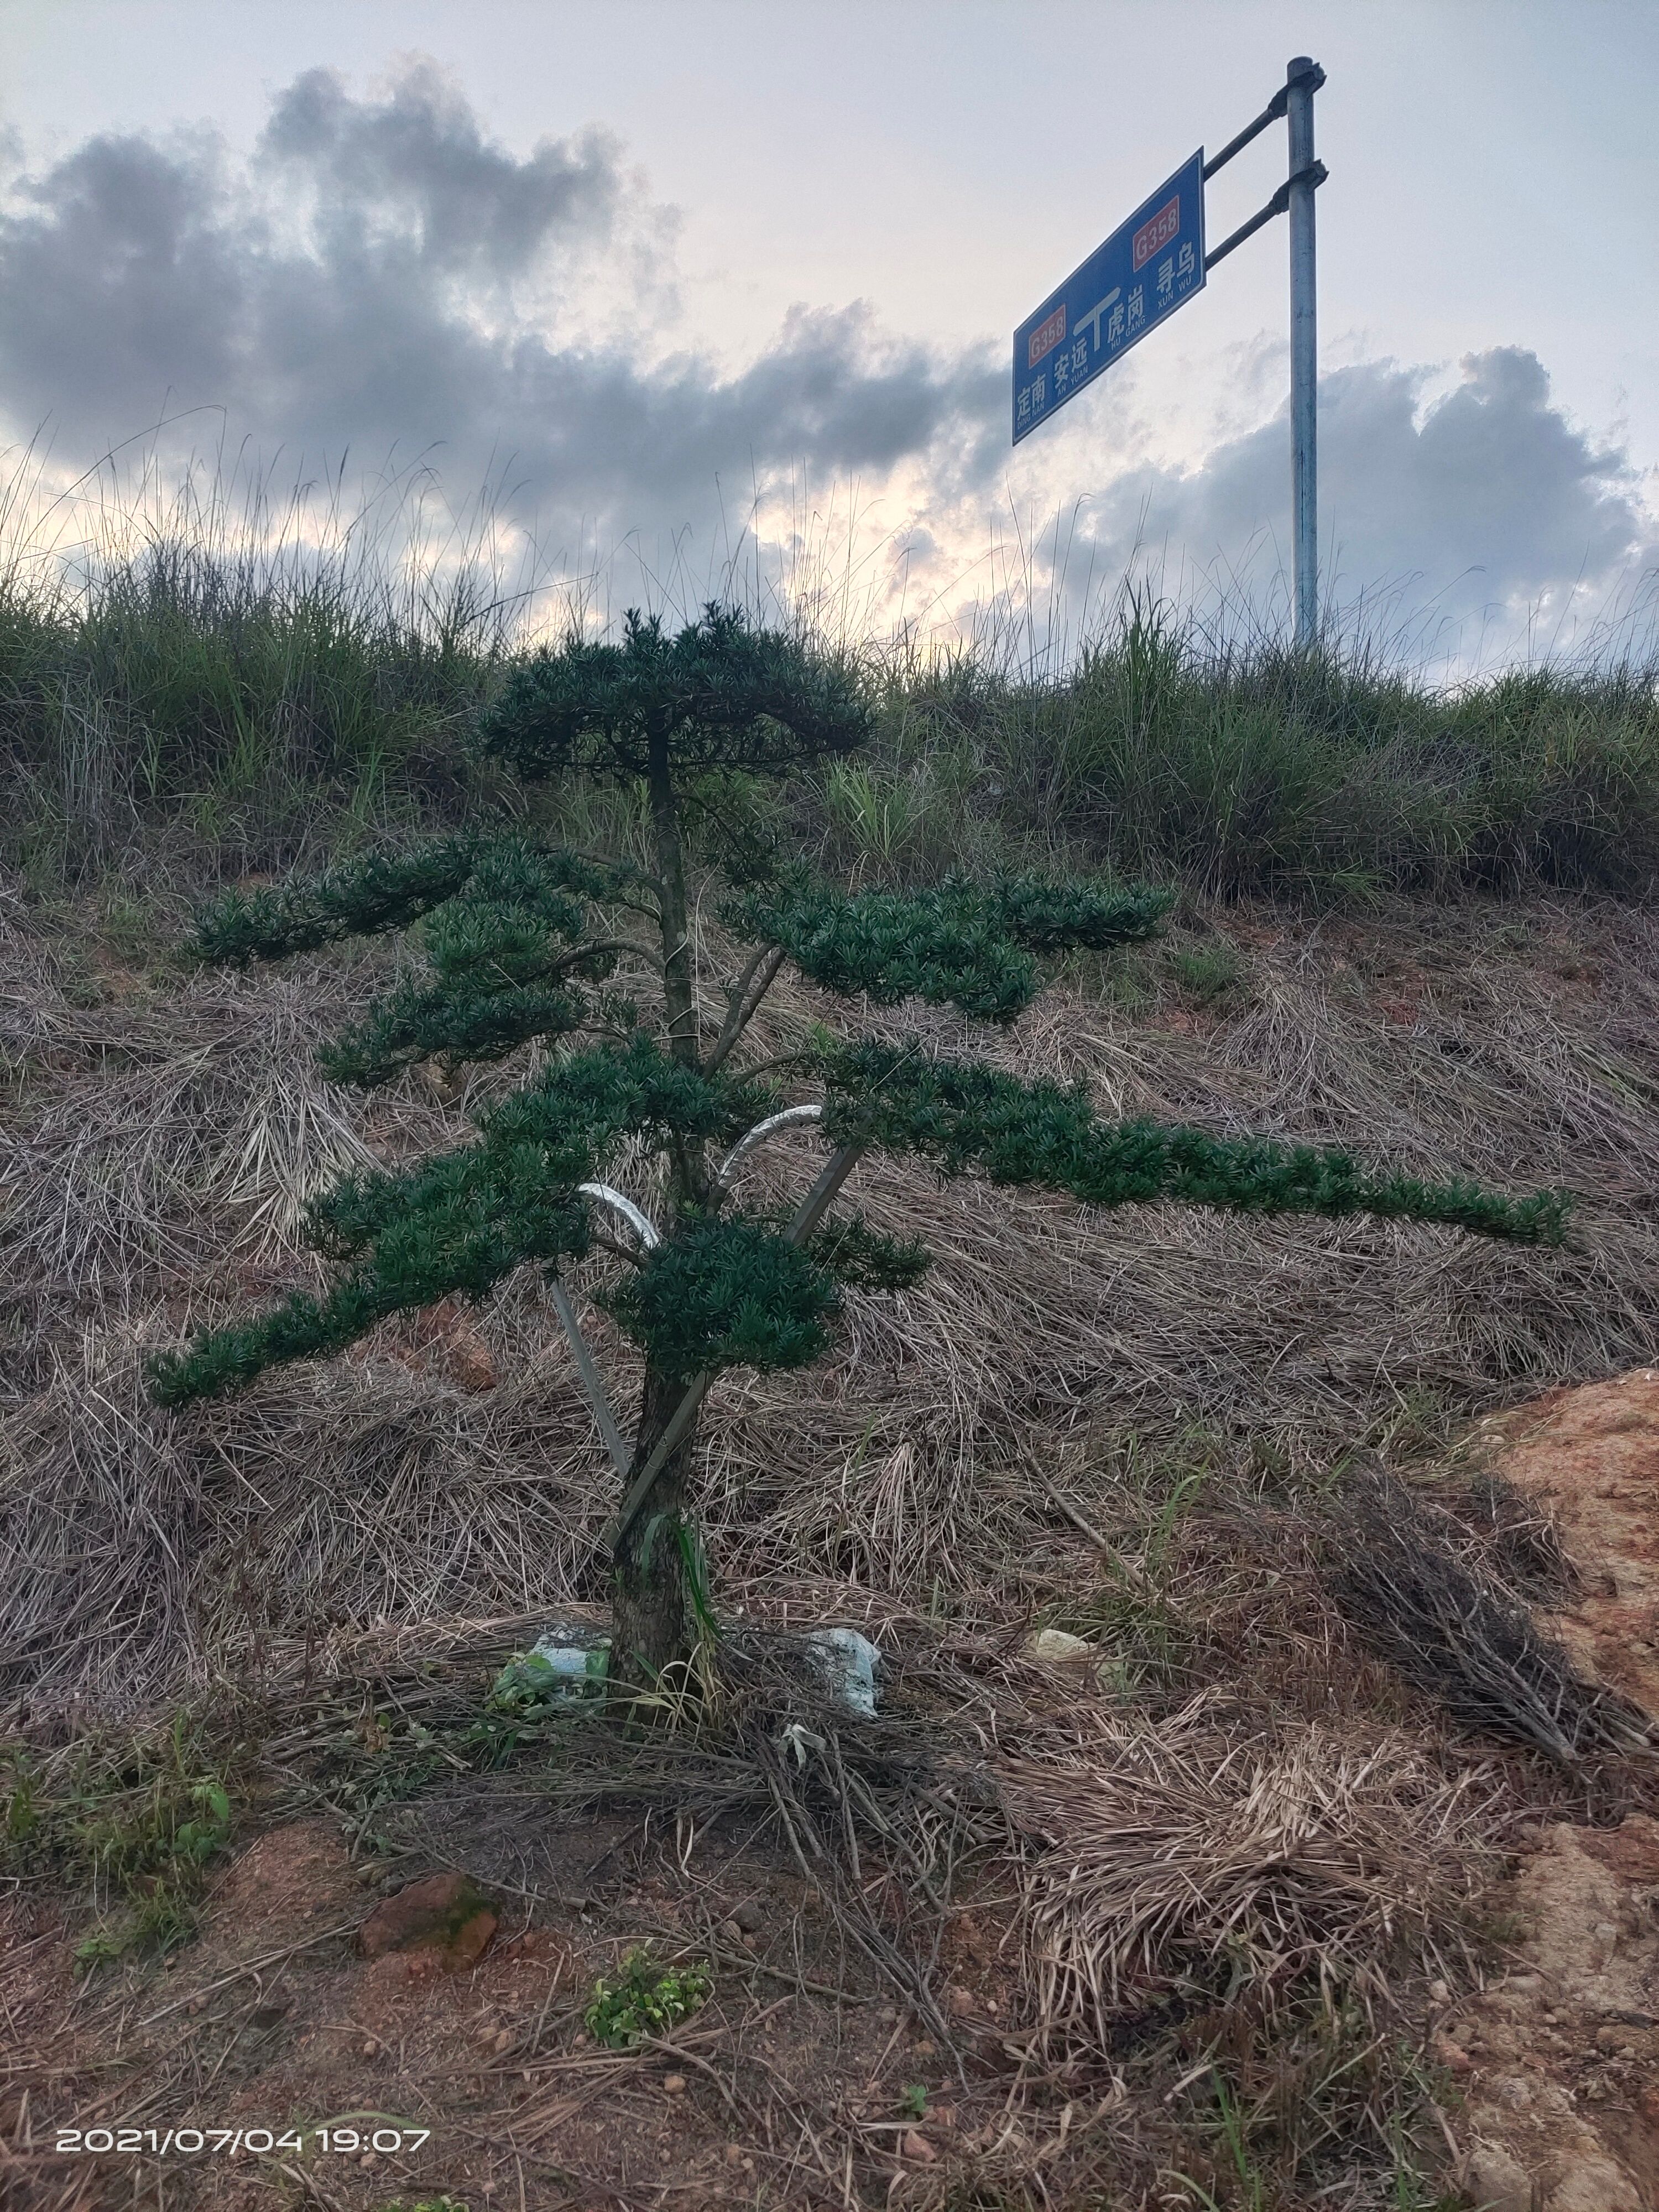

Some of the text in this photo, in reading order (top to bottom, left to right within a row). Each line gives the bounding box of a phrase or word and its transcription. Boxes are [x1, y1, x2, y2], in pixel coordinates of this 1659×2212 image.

[1136, 208, 1177, 260] G358
[1156, 241, 1195, 294] 寻乌
[1107, 284, 1144, 343] 虎岗
[1157, 275, 1192, 310] XUN WU
[1031, 316, 1063, 358] G358
[1111, 315, 1146, 351] HU GANG
[1054, 337, 1087, 389] 安远
[1057, 365, 1088, 397] AN YUAN
[1017, 373, 1046, 421] 定南
[1017, 402, 1045, 430] DING NAN
